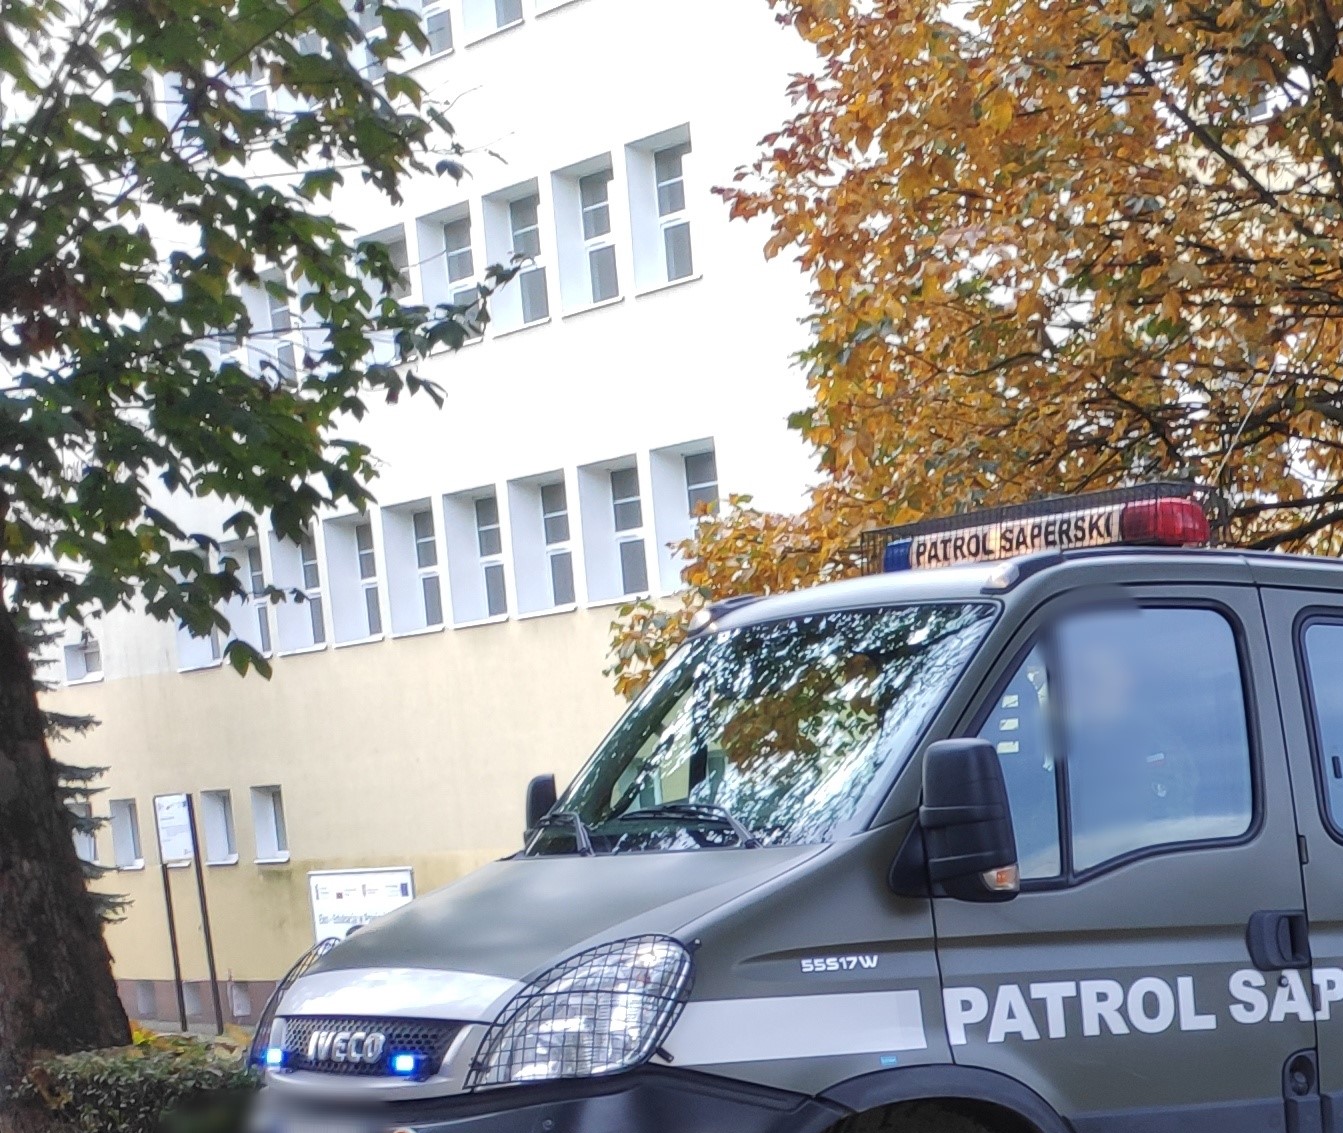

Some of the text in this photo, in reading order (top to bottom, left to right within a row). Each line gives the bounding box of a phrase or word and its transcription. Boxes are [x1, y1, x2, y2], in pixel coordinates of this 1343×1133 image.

[916, 511, 1112, 565] PATROL SAPERSKI
[801, 954, 878, 973] 55S17W
[943, 976, 1217, 1046] PATROL
[307, 1030, 385, 1063] IVECO
